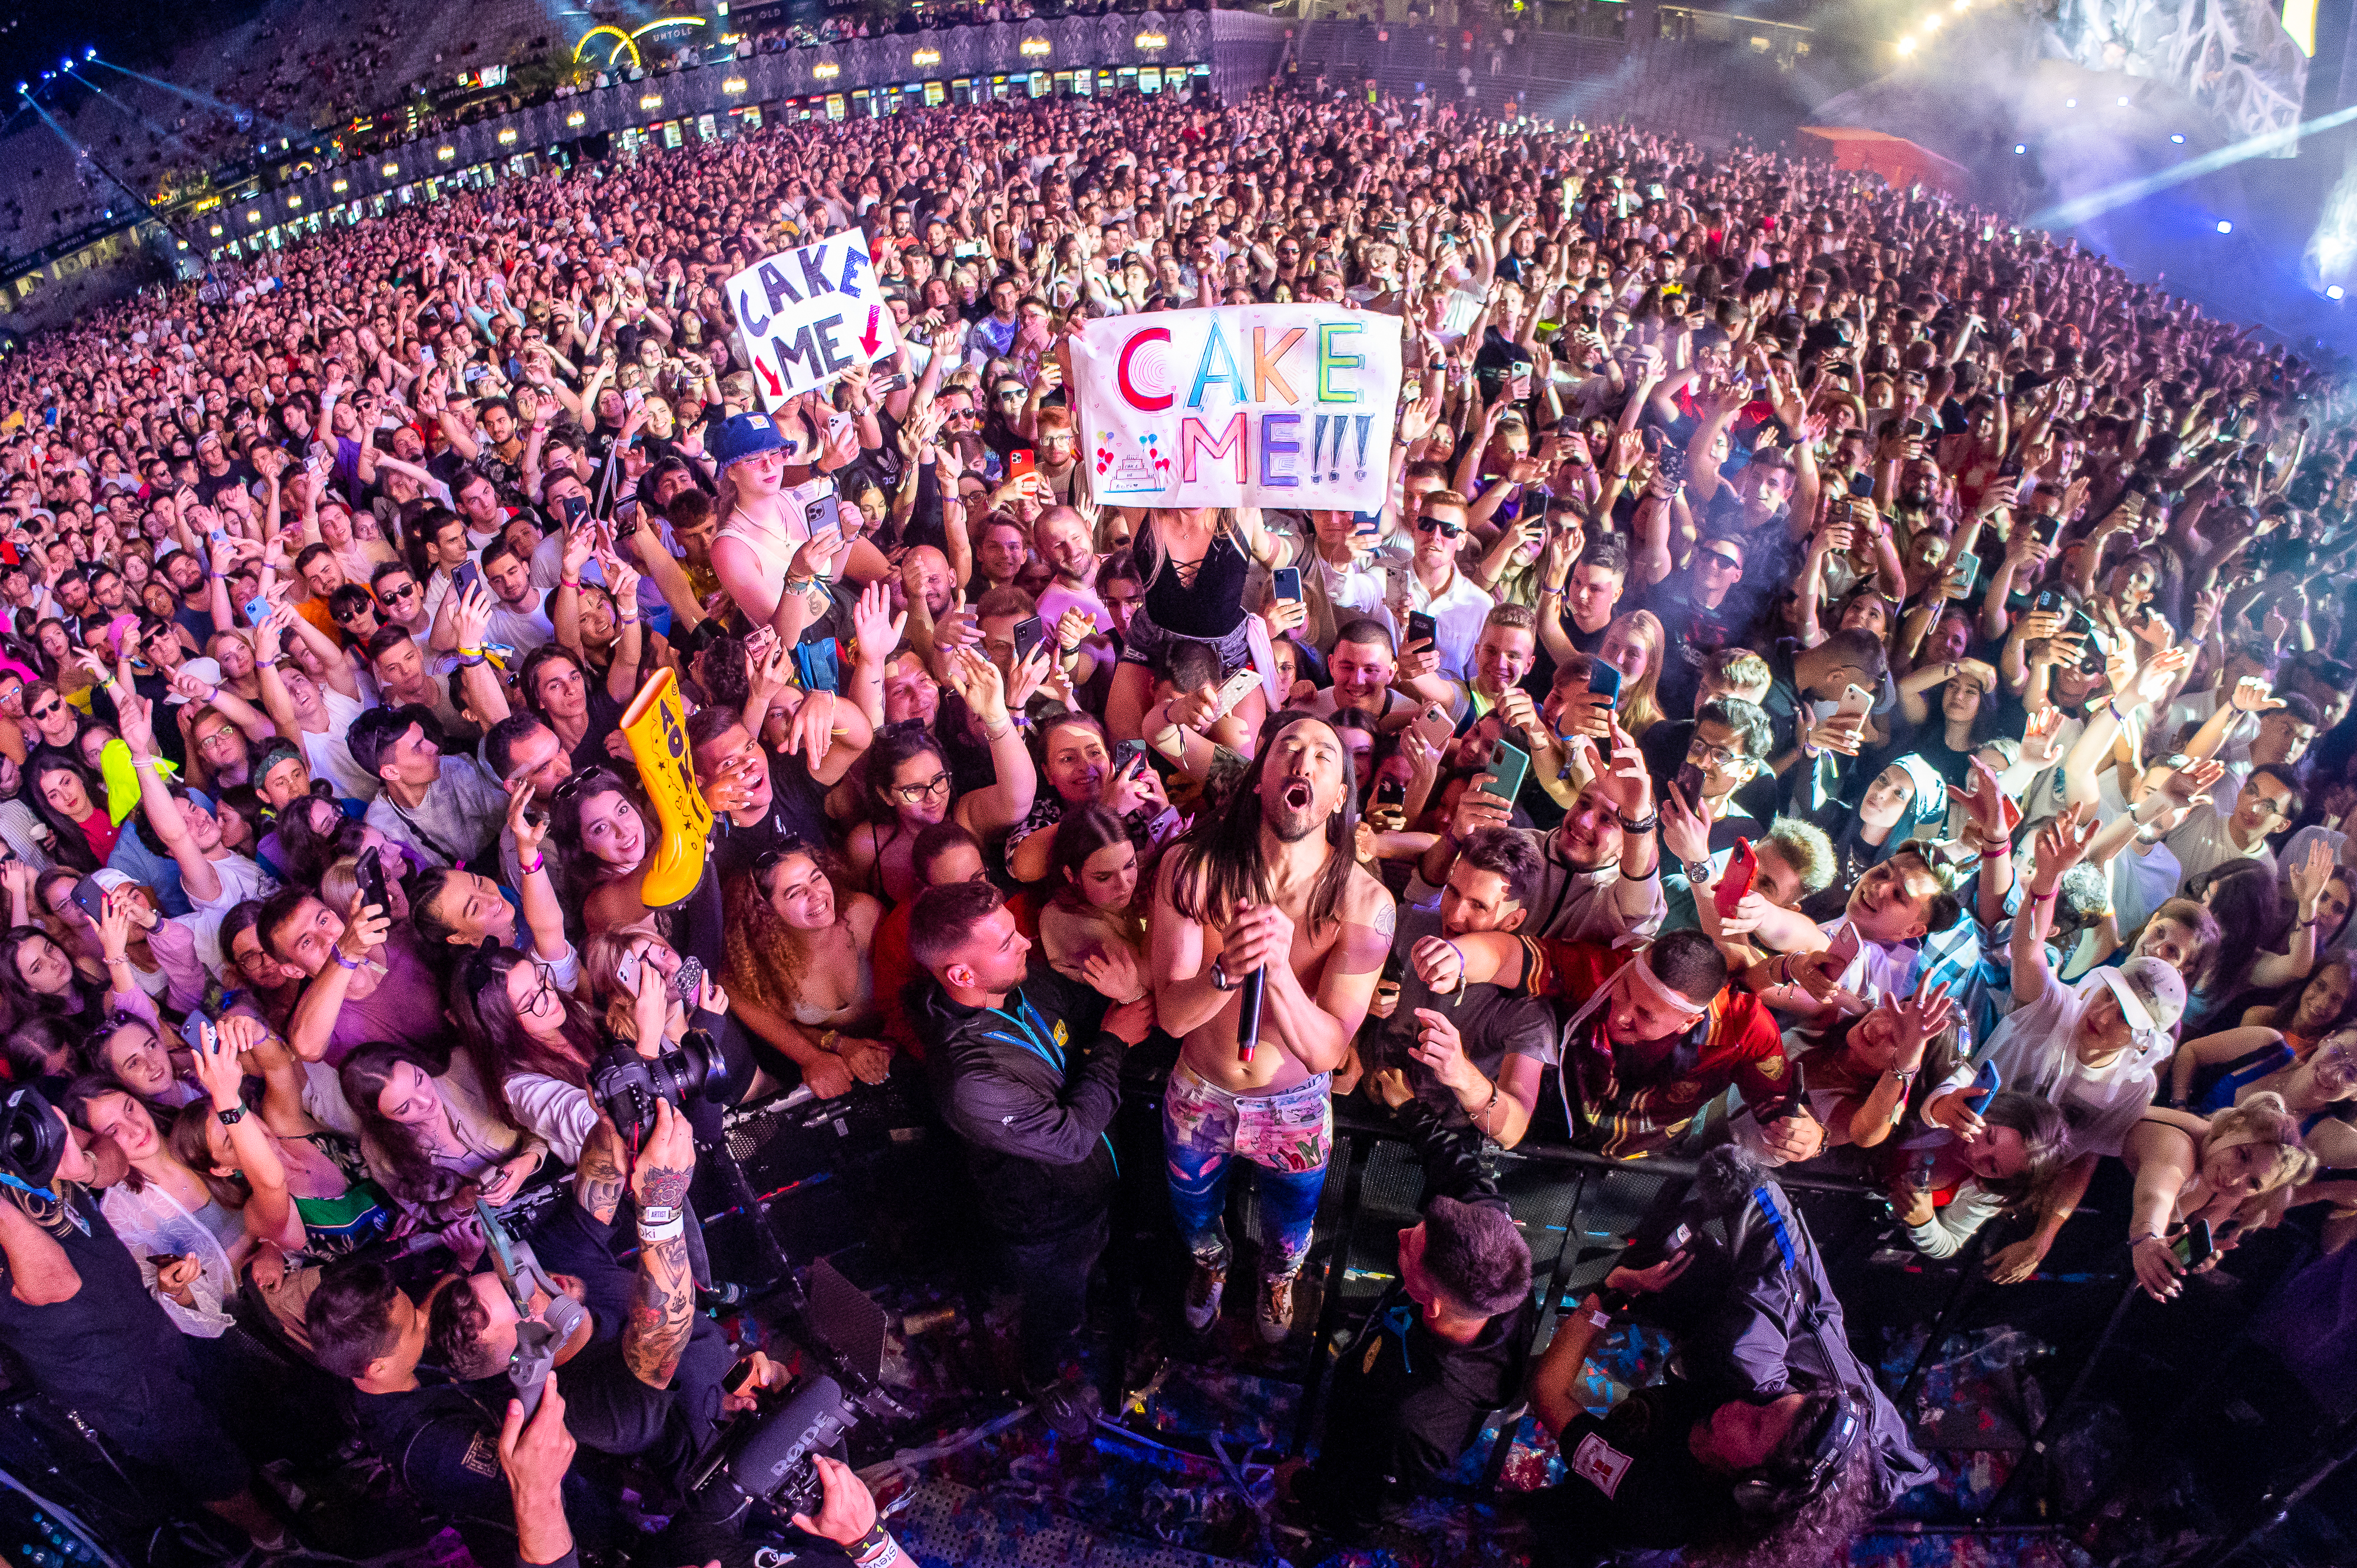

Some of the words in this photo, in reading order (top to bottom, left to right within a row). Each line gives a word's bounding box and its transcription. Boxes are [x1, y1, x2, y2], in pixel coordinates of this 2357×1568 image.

[652, 27, 692, 42] UNTOLD
[737, 8, 780, 24] UNOLD
[740, 245, 869, 337] CAKE
[771, 313, 854, 389] ME
[1117, 322, 1364, 411] CAKE
